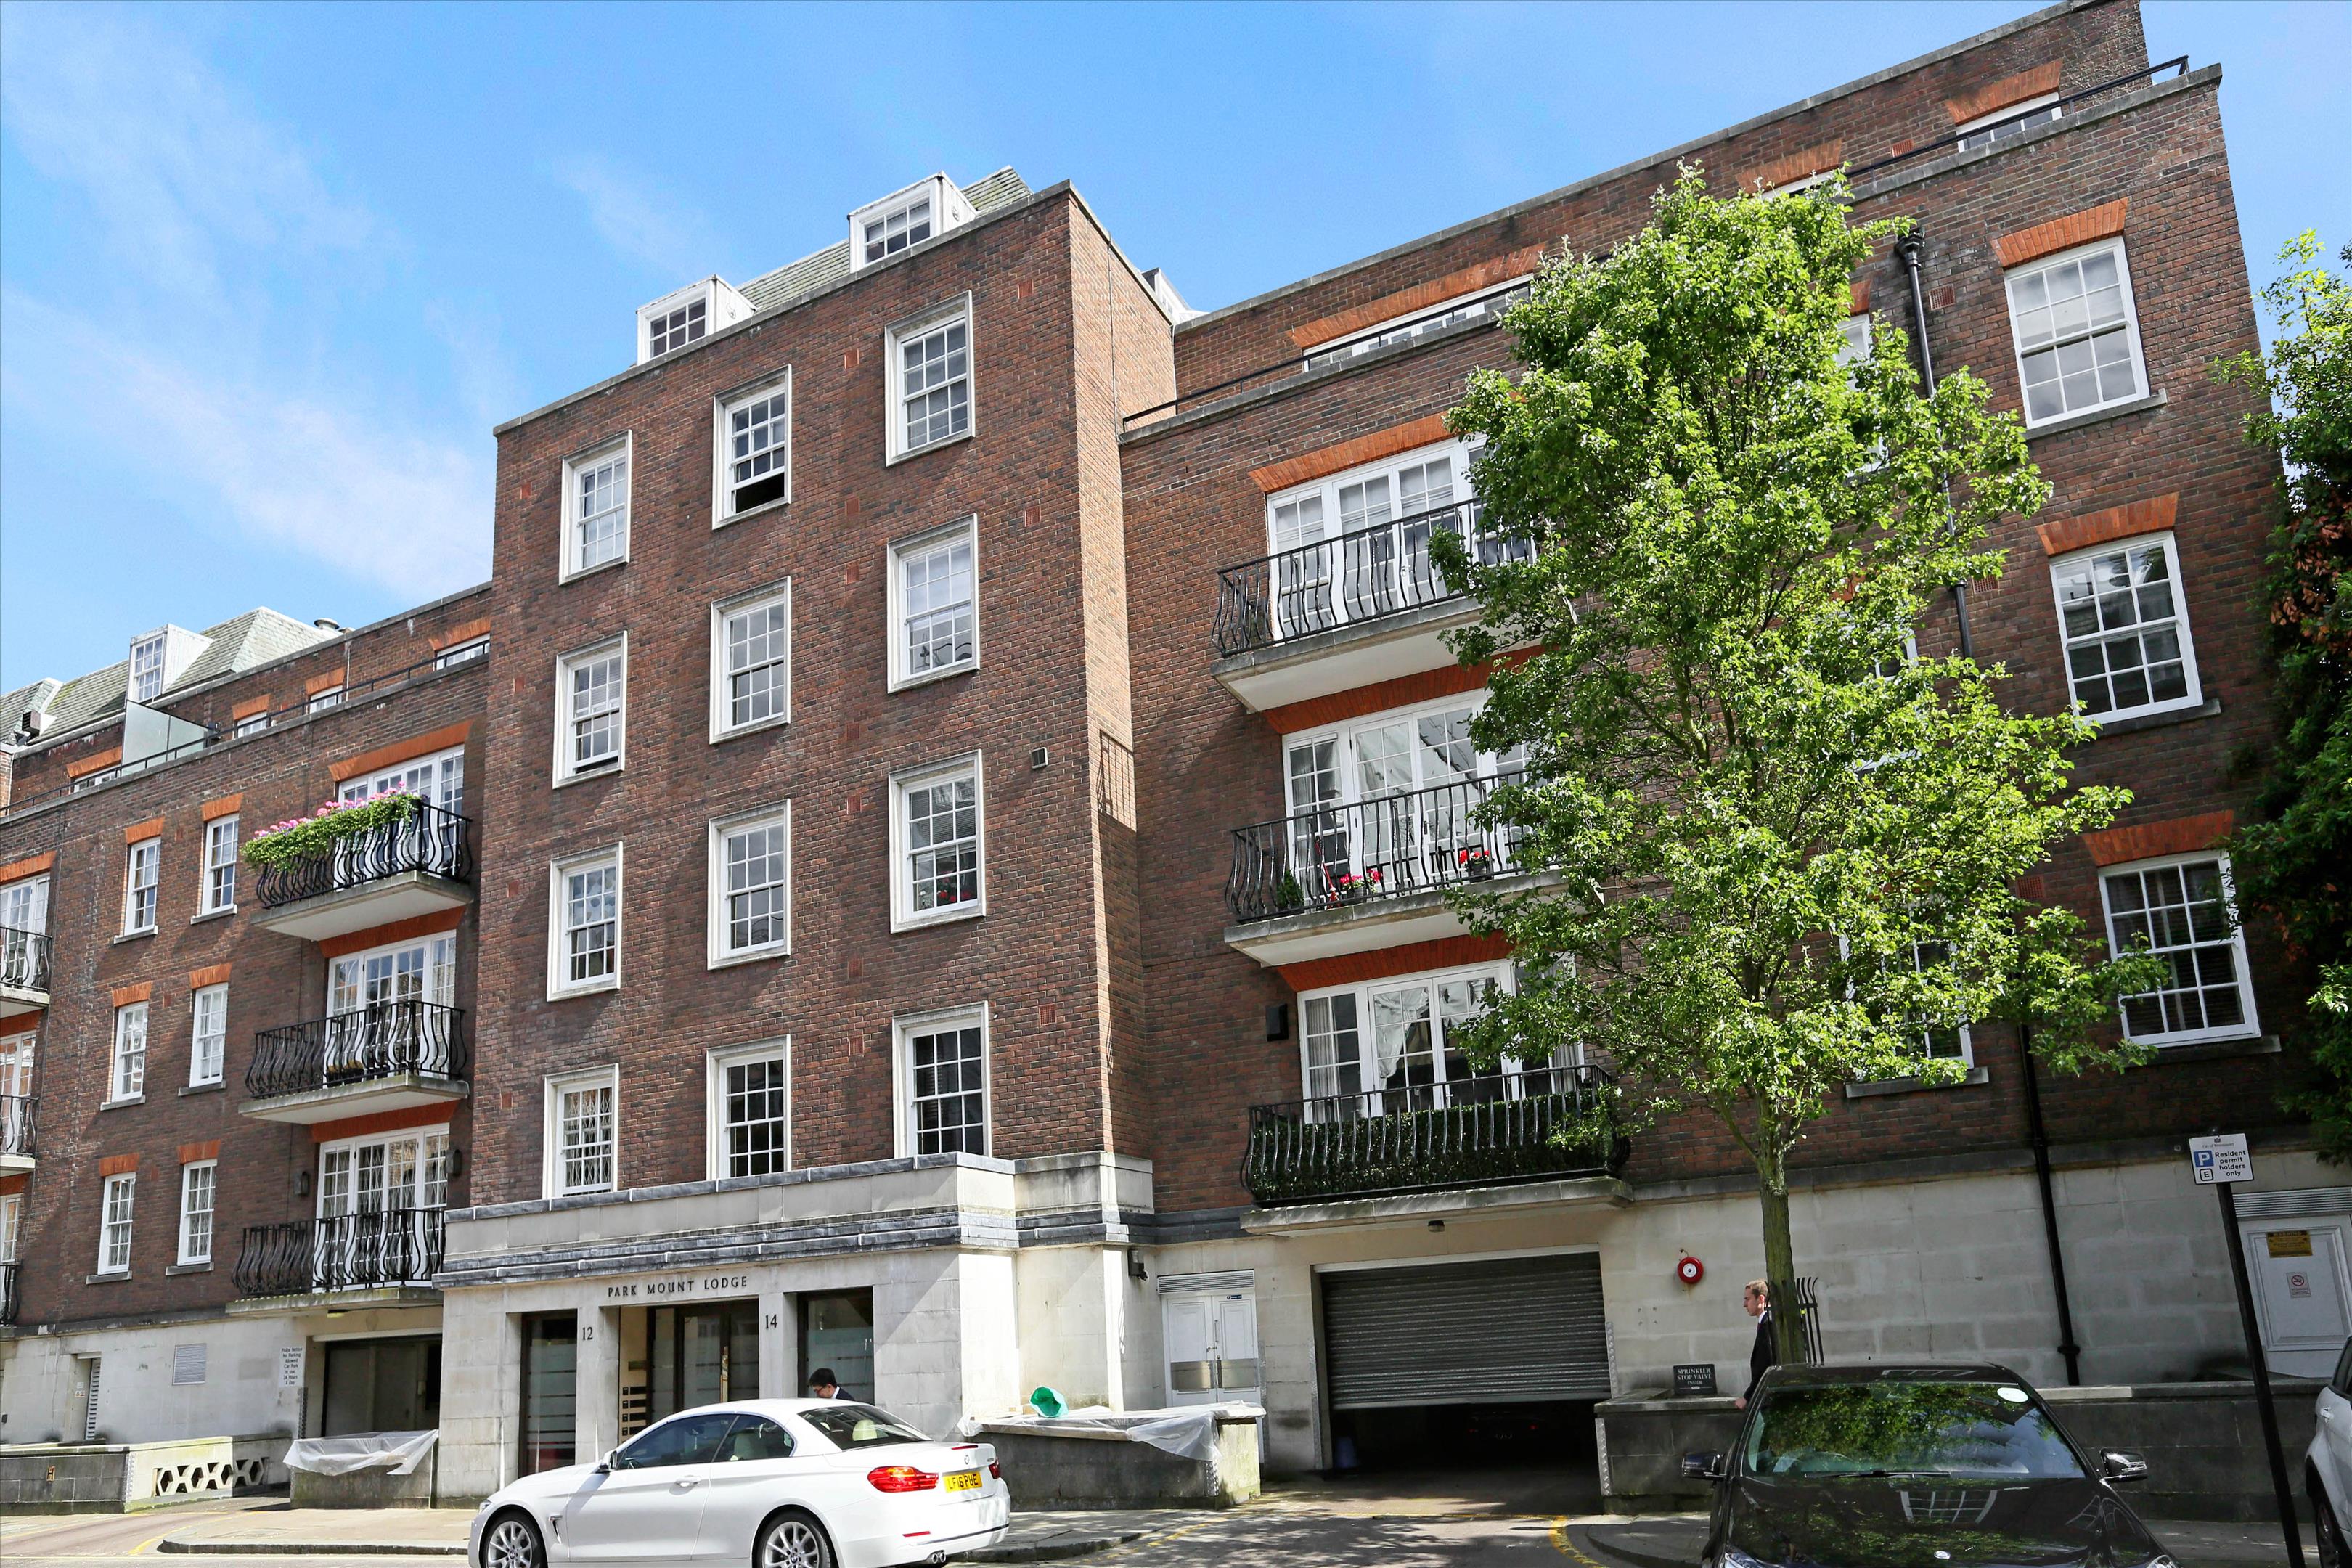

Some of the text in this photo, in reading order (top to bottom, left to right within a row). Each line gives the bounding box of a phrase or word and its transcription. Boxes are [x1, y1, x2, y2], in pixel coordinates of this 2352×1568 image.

[2198, 1153, 2210, 1166] P
[608, 1276, 747, 1297] PARK MOUNT LODGE
[765, 1315, 777, 1329] 14
[582, 1327, 593, 1341] 12
